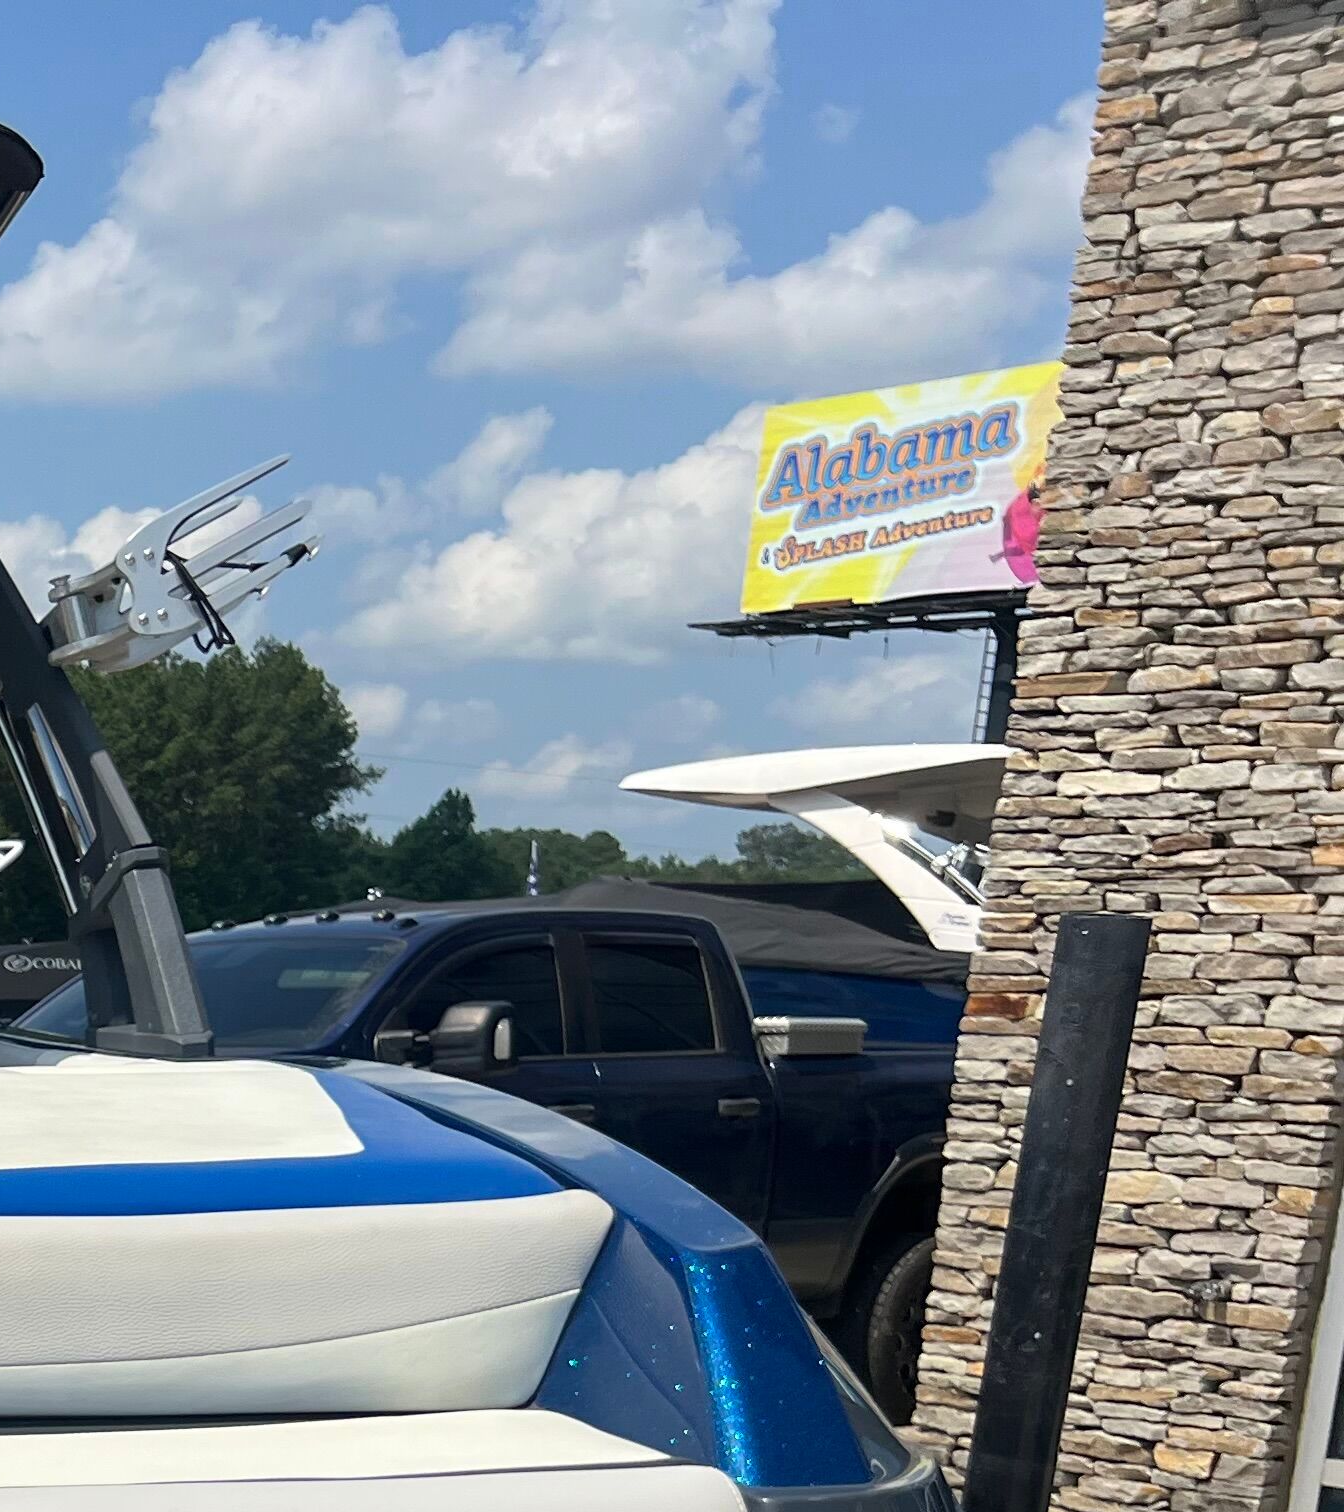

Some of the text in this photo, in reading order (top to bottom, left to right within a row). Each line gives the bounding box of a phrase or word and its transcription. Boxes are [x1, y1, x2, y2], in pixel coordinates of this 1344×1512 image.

[764, 406, 1019, 505] Alabama
[798, 464, 975, 526] Adventure
[869, 507, 993, 549] Adventure
